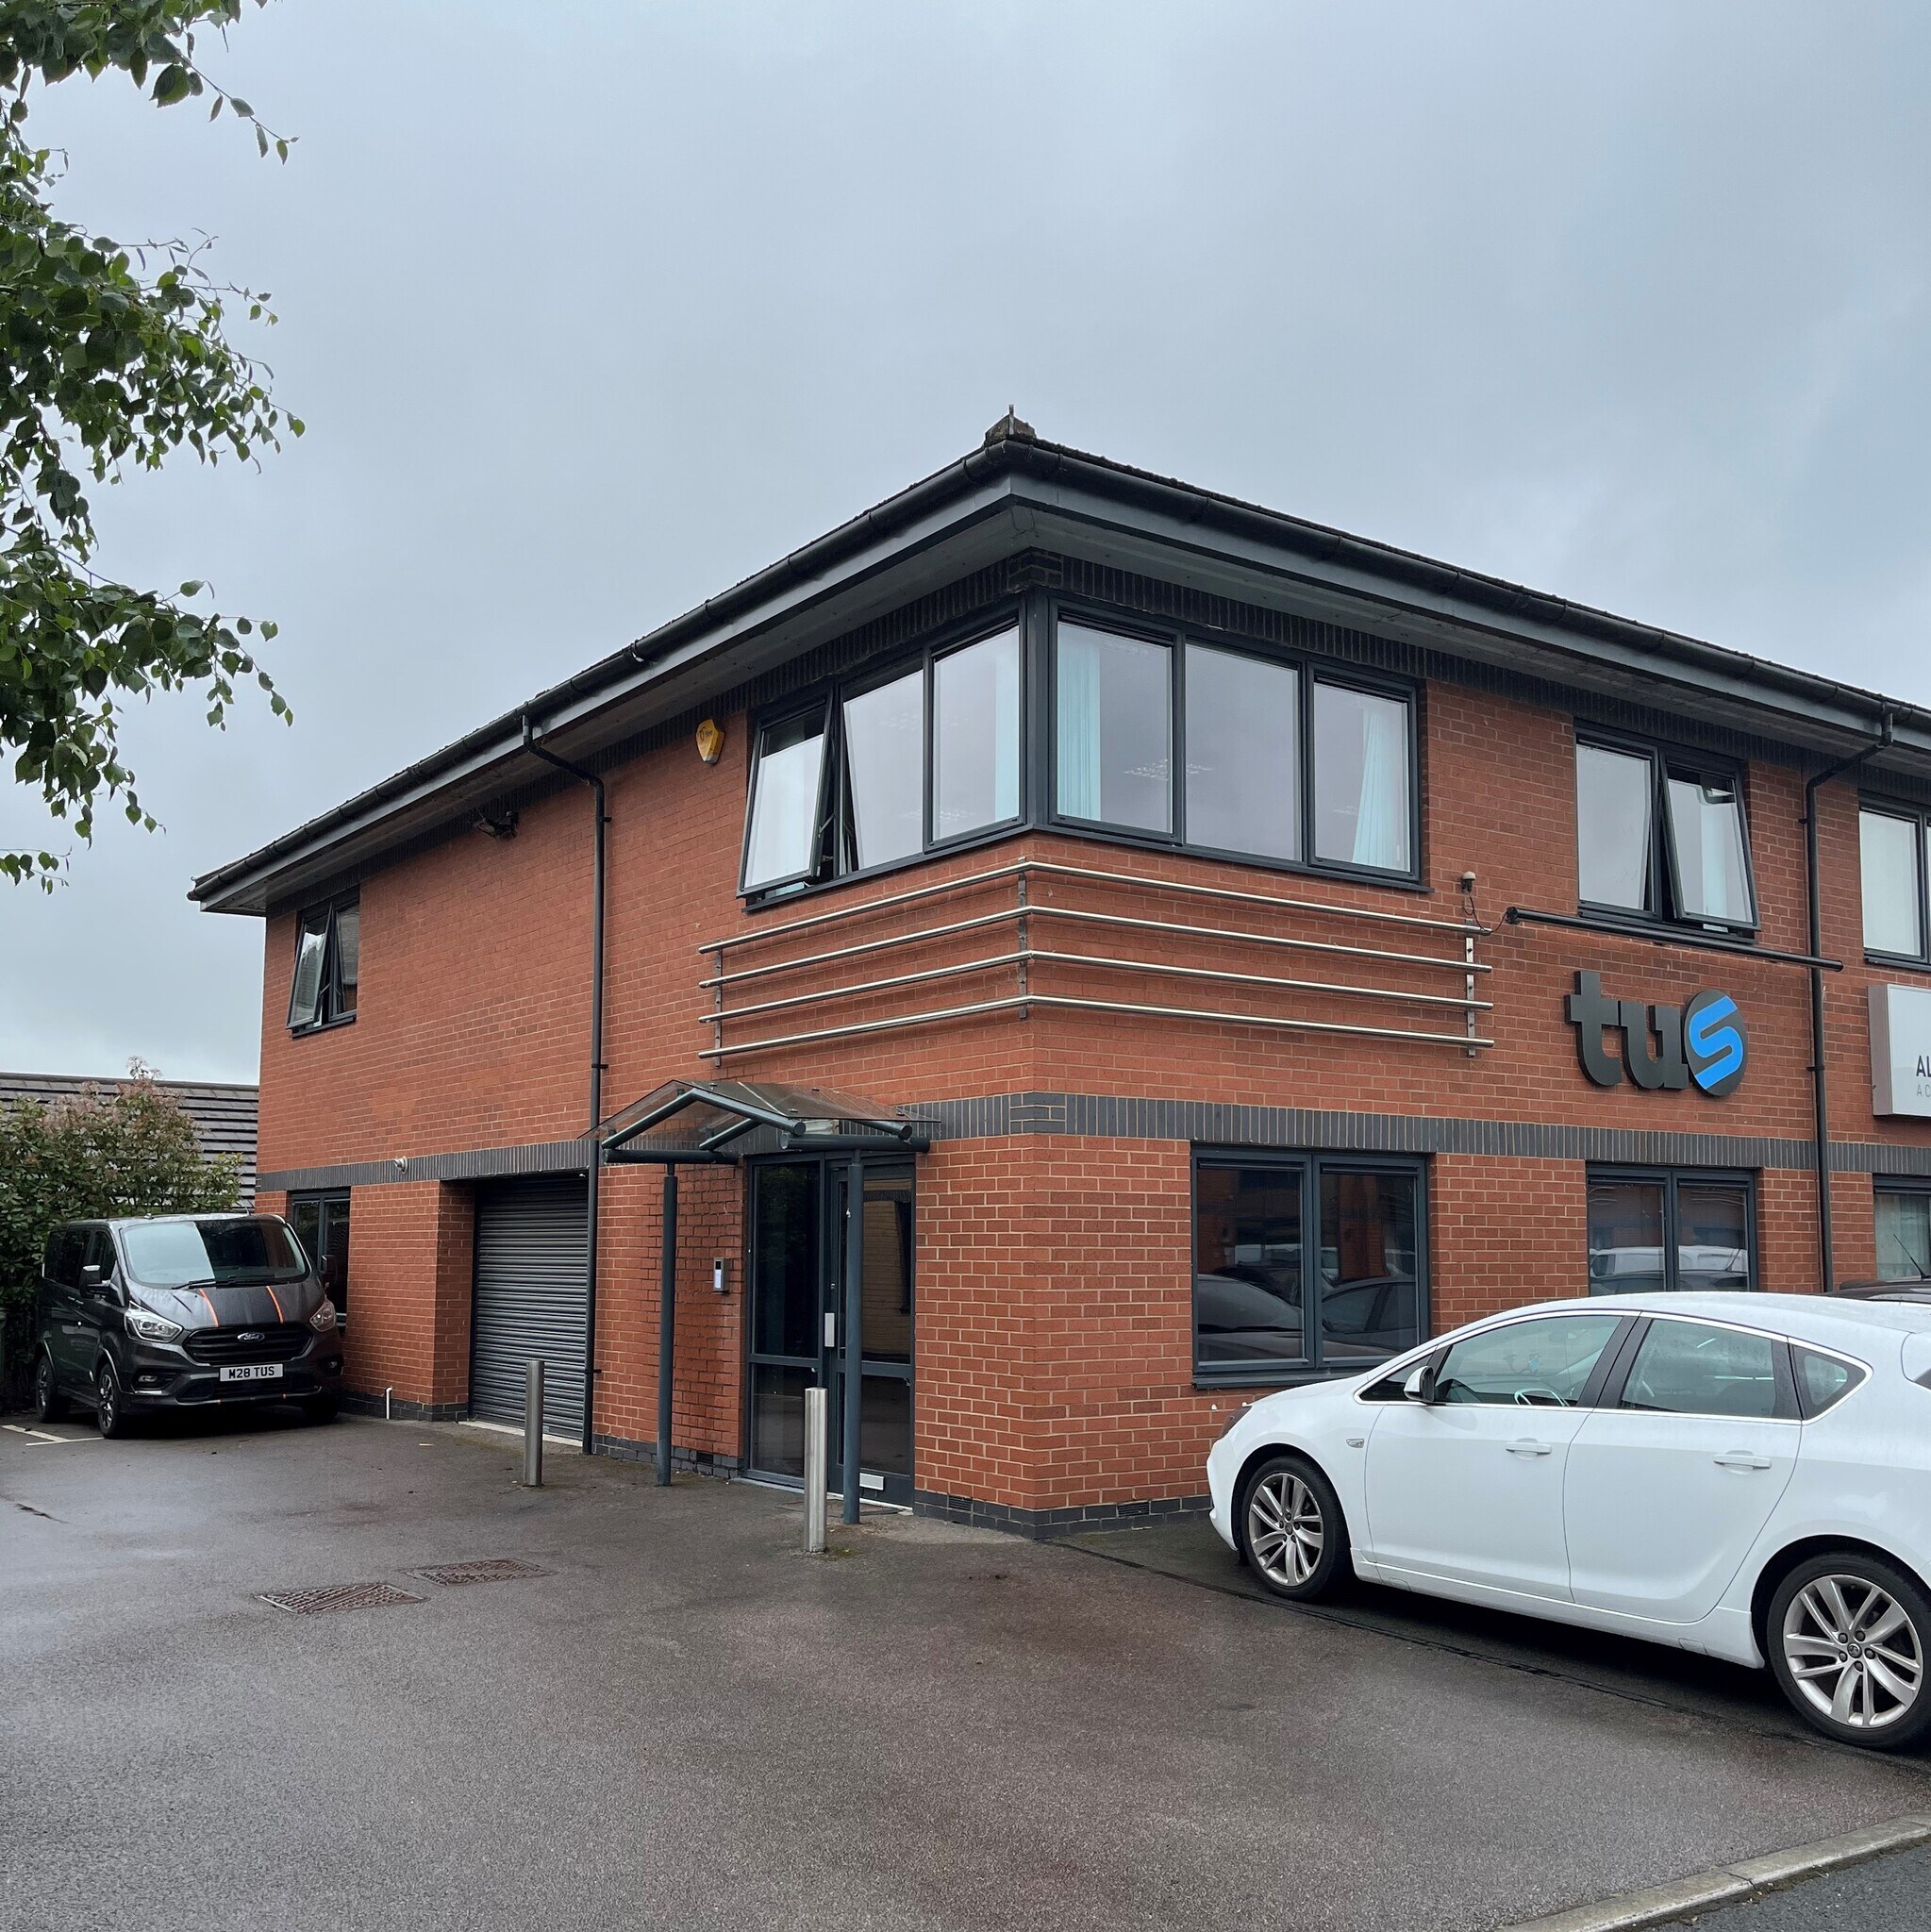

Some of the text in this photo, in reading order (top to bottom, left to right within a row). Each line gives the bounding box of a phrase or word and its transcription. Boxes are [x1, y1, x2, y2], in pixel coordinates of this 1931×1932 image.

[1565, 970, 1747, 1095] tus
[228, 1366, 275, 1379] M28 TUS
